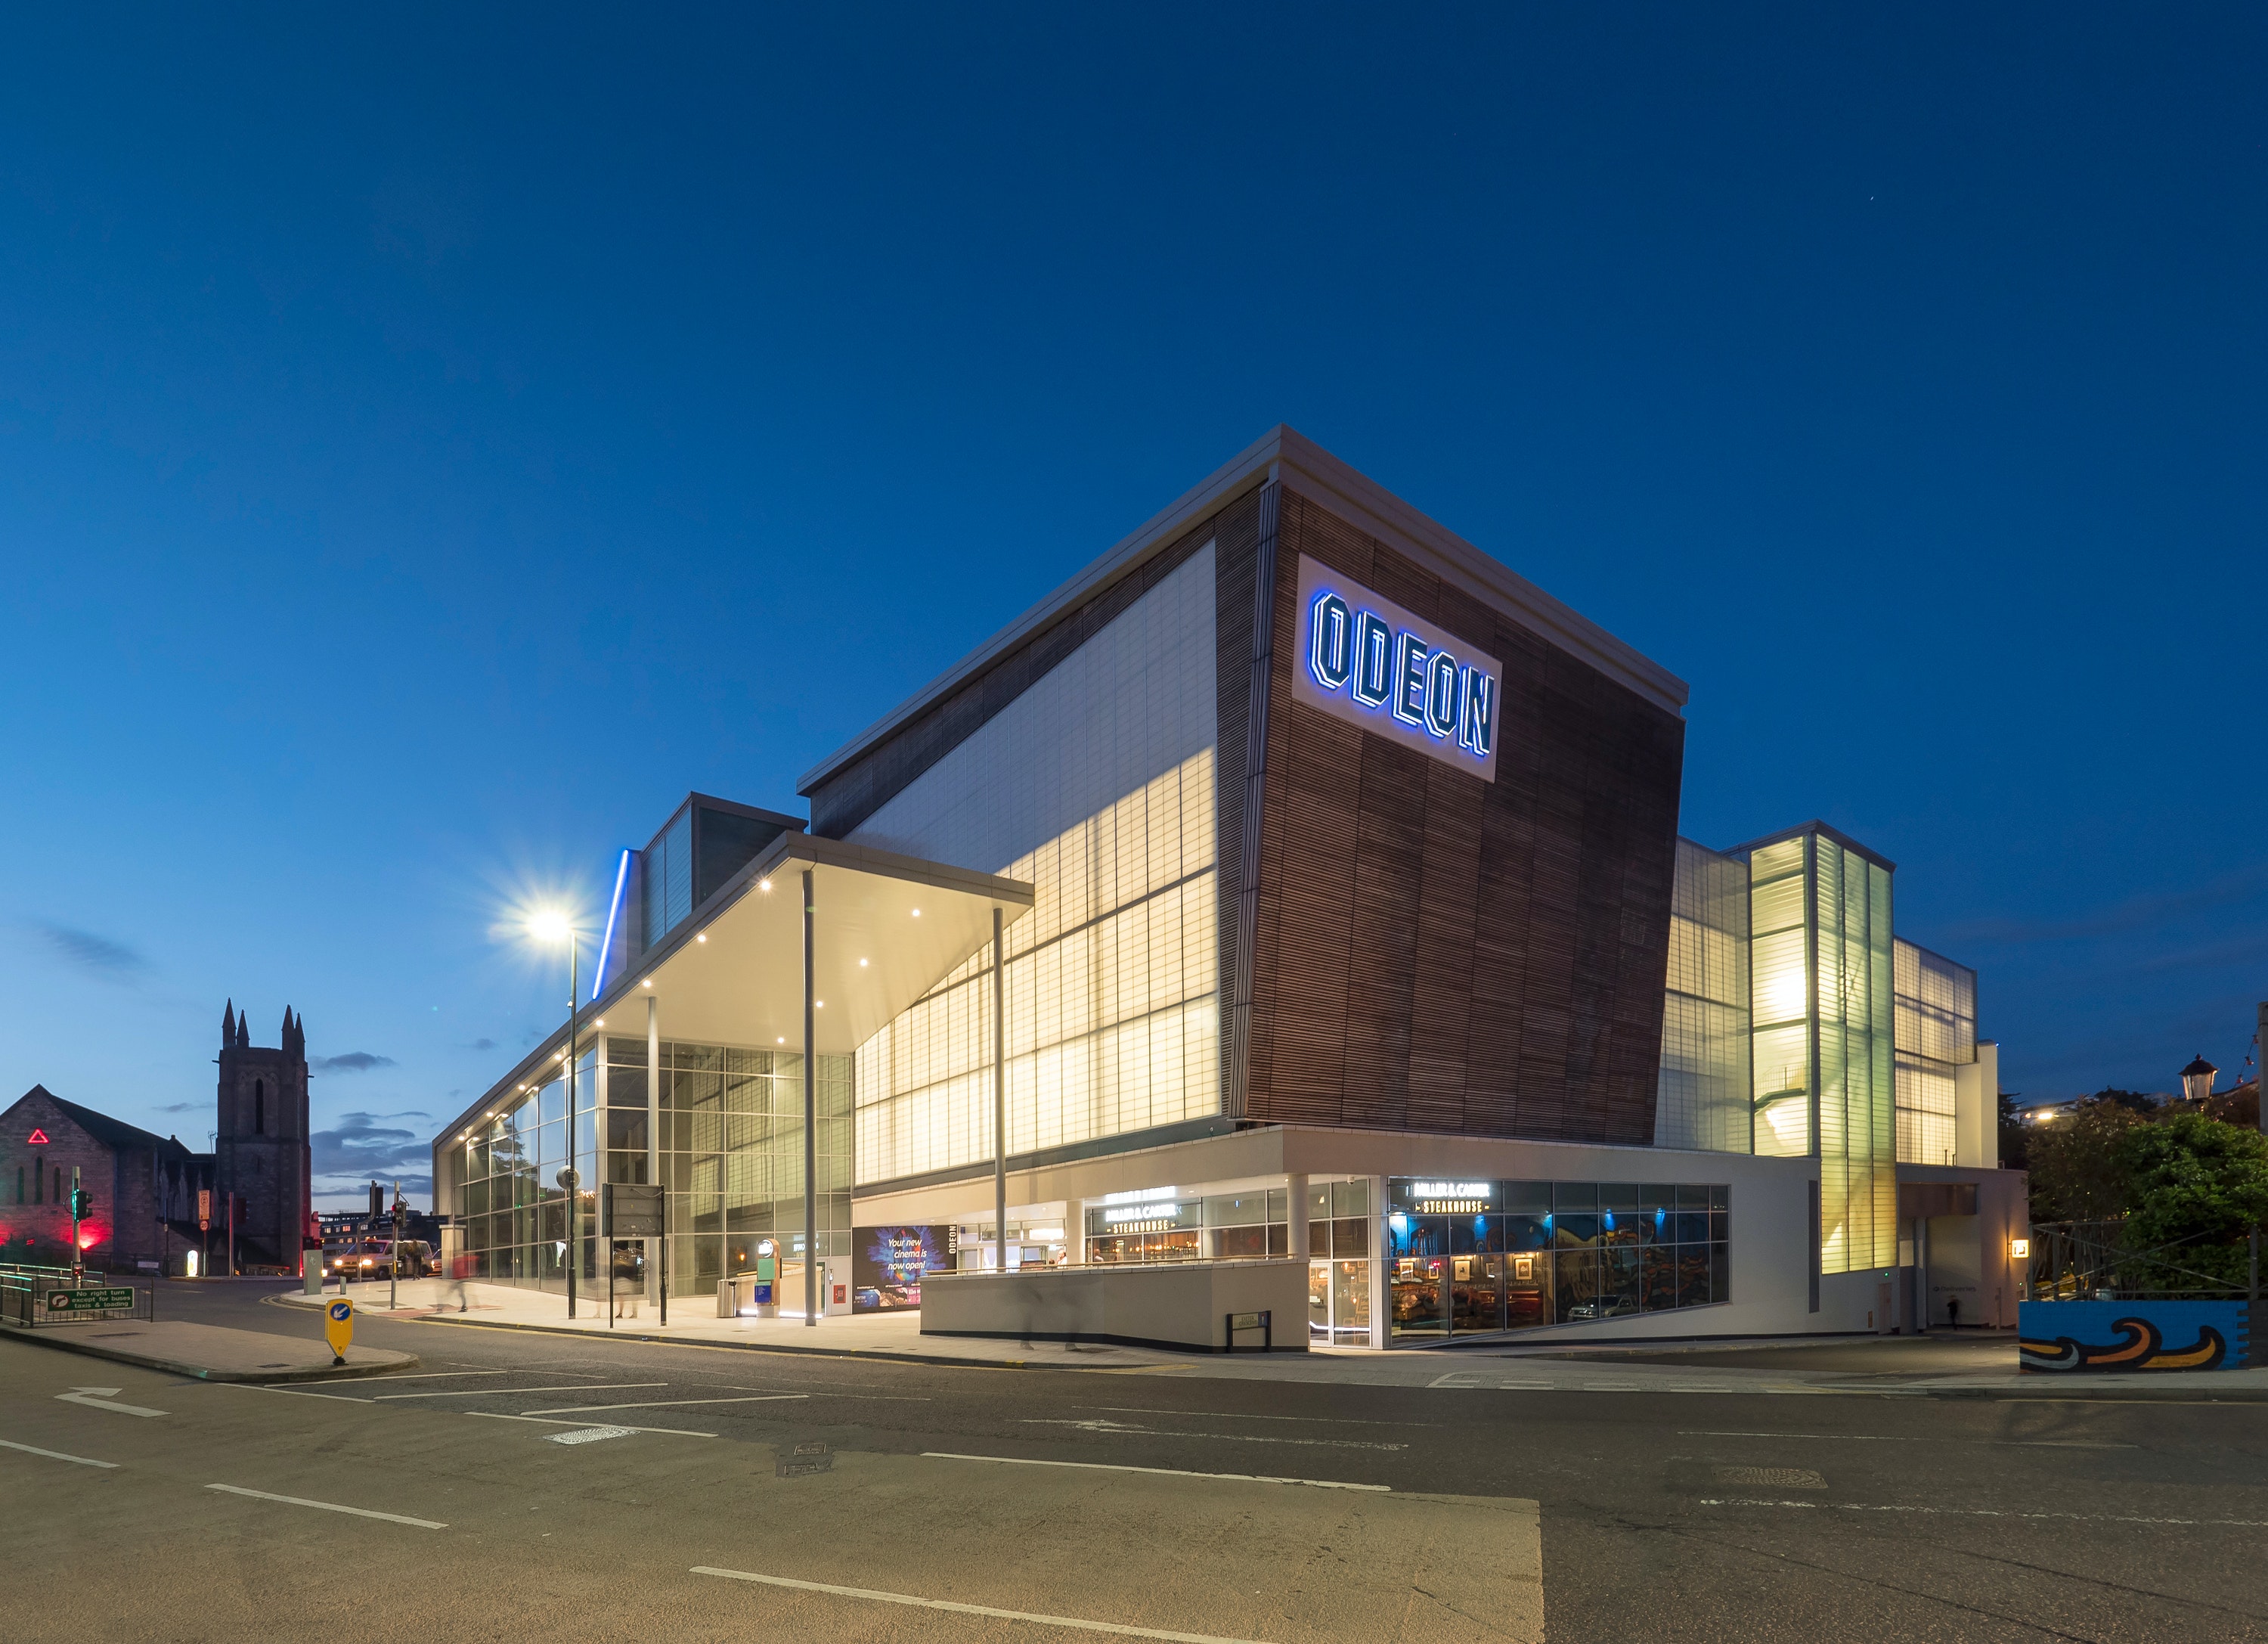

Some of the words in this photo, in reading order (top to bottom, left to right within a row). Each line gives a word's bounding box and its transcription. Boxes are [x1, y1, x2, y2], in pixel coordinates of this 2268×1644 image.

[1311, 592, 1495, 755] ODEON
[1423, 1200, 1483, 1213] STEAKHOUSE
[1113, 1219, 1169, 1234] STEAKHOUSE
[888, 1239, 905, 1247] Your
[894, 1249, 920, 1258] cinema
[921, 1249, 927, 1258] is
[888, 1262, 905, 1270] now
[905, 1261, 925, 1270] open!
